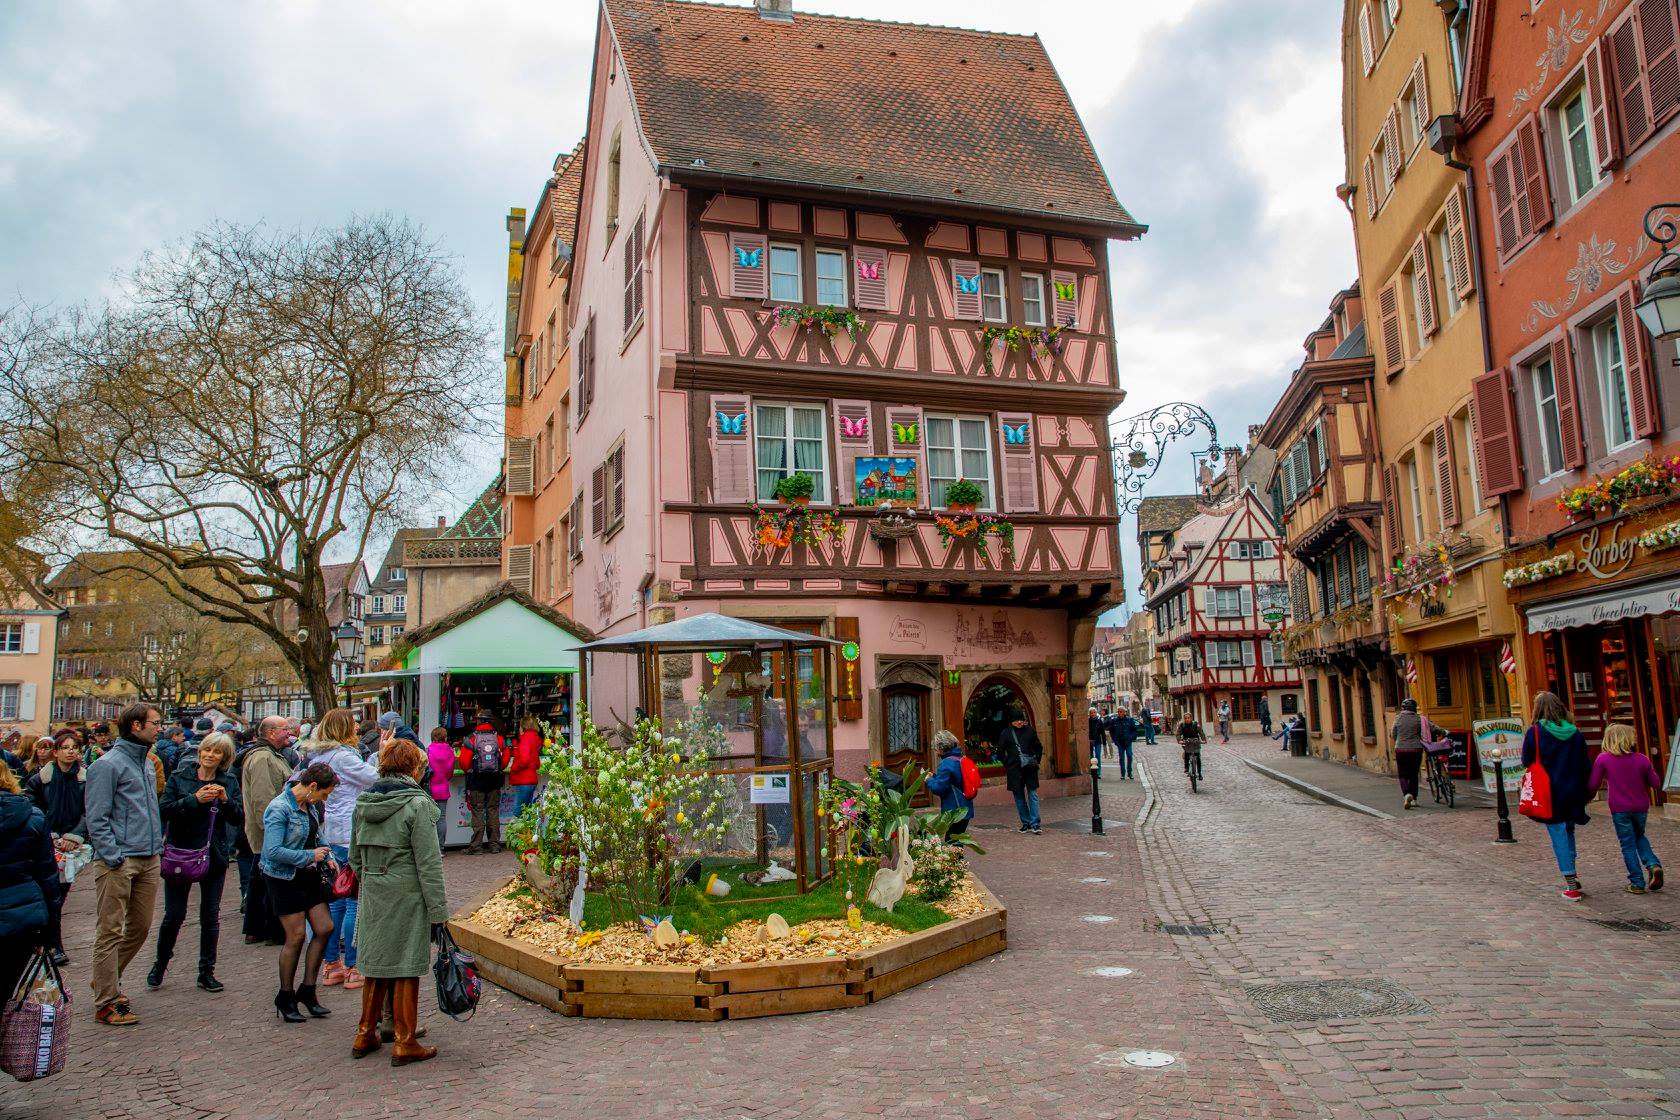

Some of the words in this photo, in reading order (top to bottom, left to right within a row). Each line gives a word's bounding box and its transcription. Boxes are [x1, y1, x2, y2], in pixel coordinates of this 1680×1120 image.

[1577, 521, 1638, 579] Lorber
[1592, 601, 1648, 621] Chocolatier
[40, 1027, 53, 1047] BAG
[35, 1048, 51, 1078] PINKO
